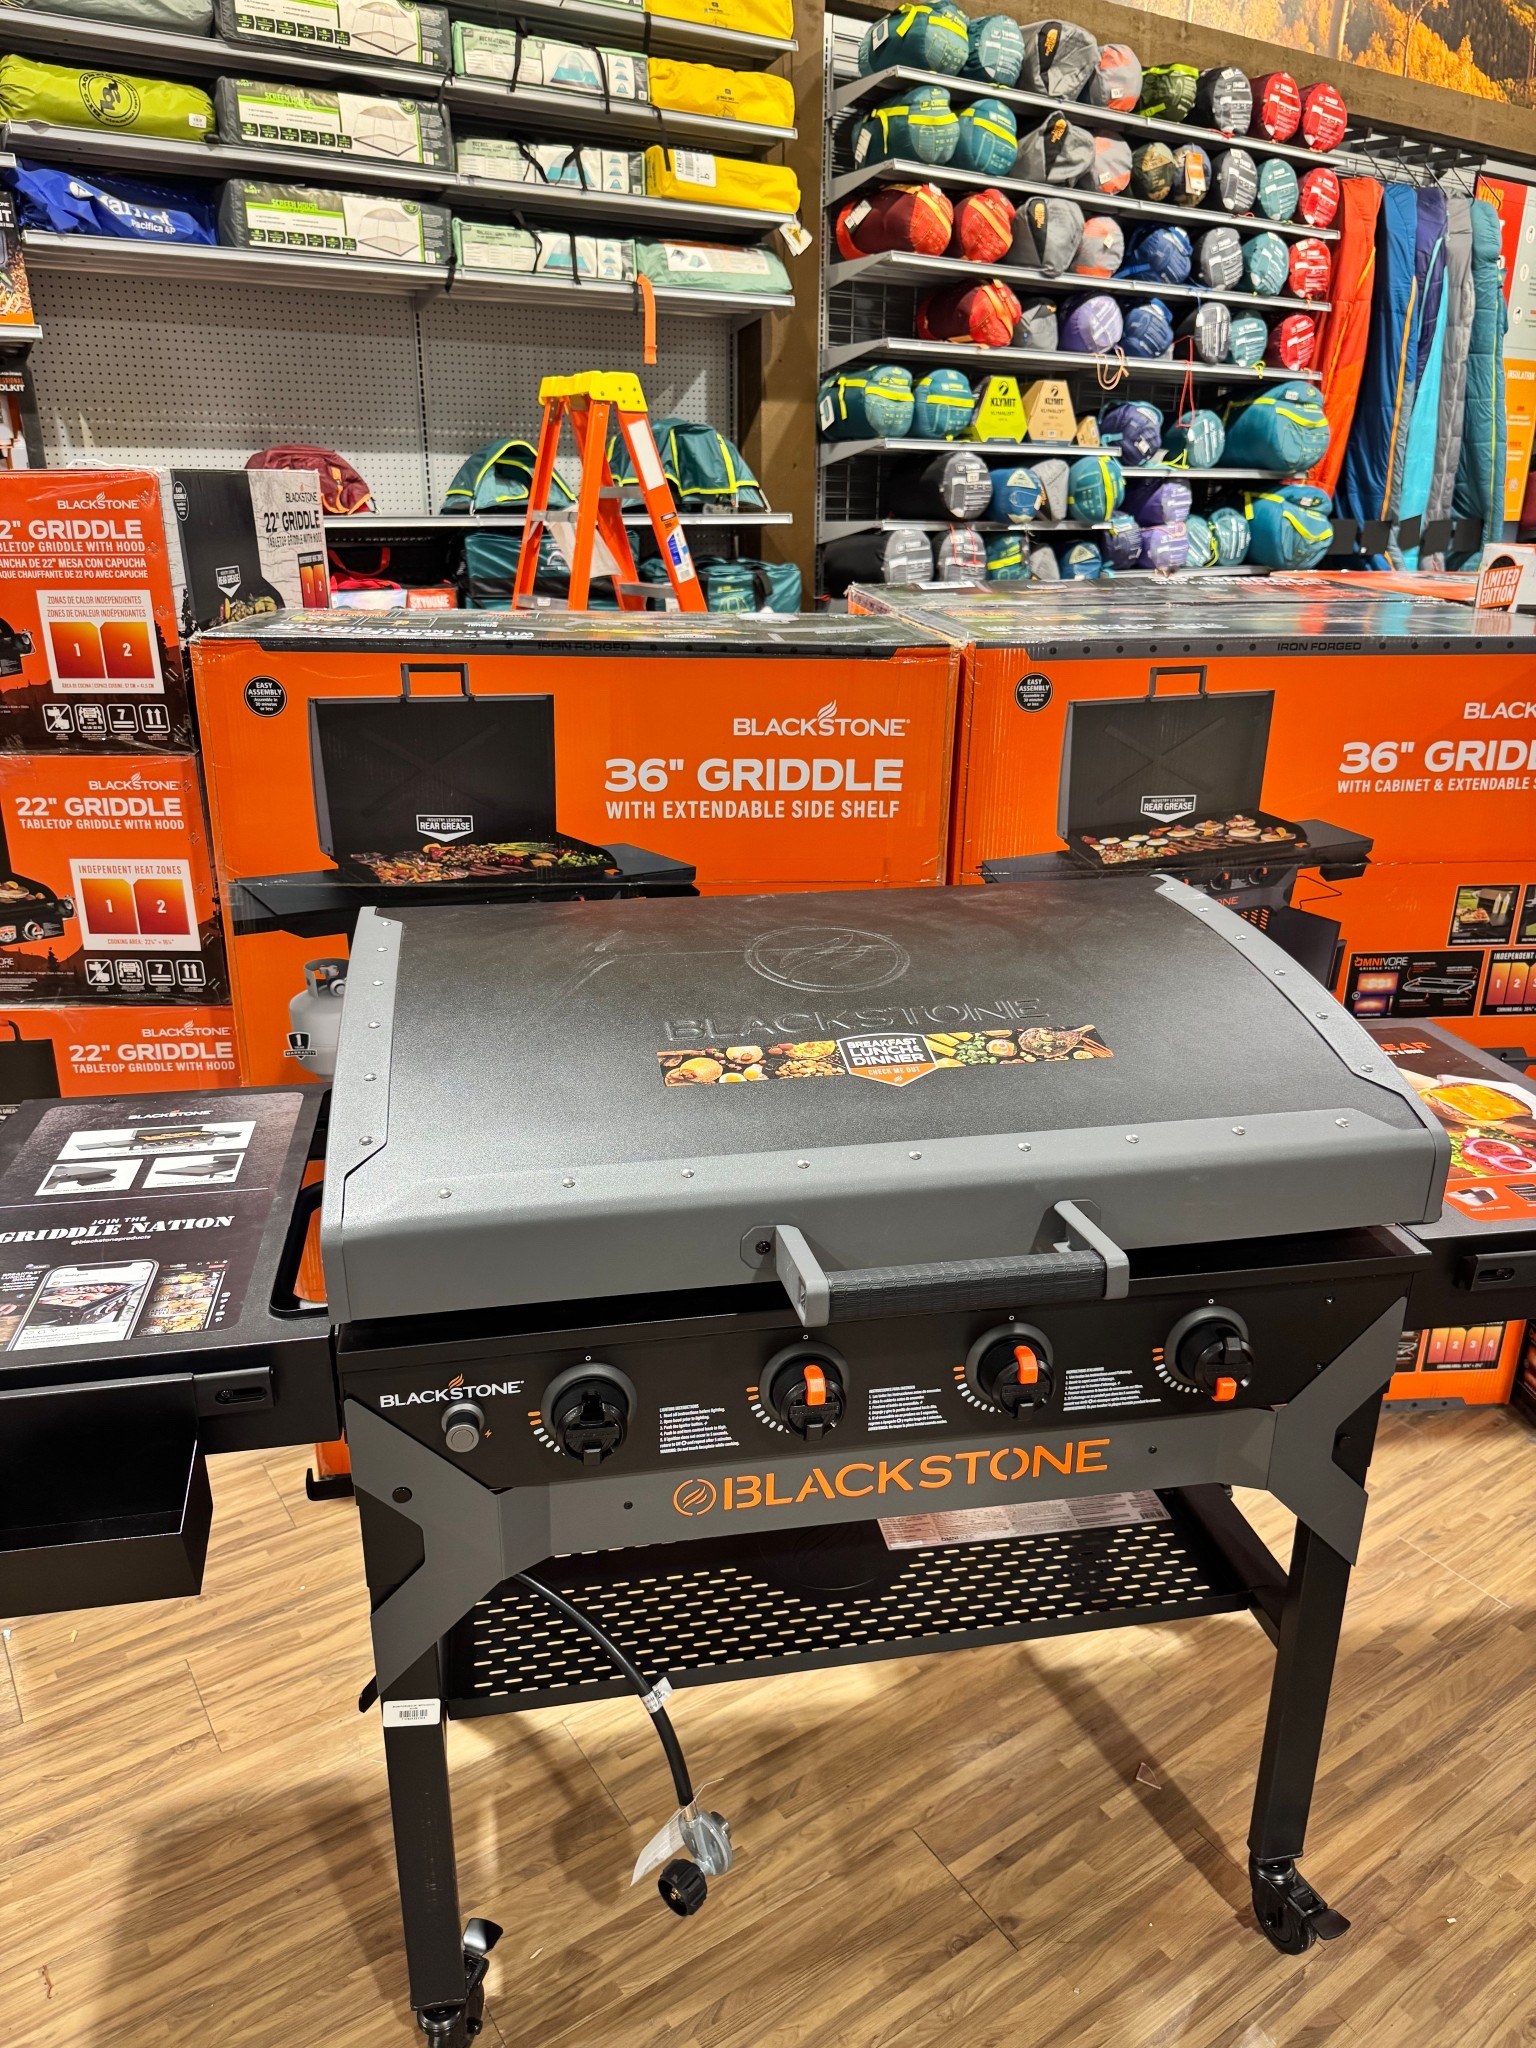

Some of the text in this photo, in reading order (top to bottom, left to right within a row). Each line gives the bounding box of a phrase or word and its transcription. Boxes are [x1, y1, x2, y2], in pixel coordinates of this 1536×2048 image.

[131, 219, 176, 234] Pacifica 4P
[1507, 370, 1535, 380] INSULATION
[991, 398, 1016, 407] KLYMIT
[1045, 398, 1064, 406] KLYMIT
[285, 492, 318, 503] BLACKSTONE
[57, 499, 139, 509] BLACKSTONE
[264, 510, 320, 533] 22" GRIDDLE
[28, 520, 143, 539] GRIDDLE
[38, 542, 83, 552] GRIDDLE
[86, 542, 113, 552] WITH
[117, 542, 145, 552] HOOD
[29, 559, 41, 568] DE
[42, 558, 56, 568] 22"
[58, 559, 83, 568] MESA
[85, 559, 103, 568] CON
[106, 558, 146, 568] CAPUCHA
[18, 570, 148, 578] CHAUFFANTE DE 22 PO AVEC CAPUCHE
[1483, 568, 1520, 588] LIMITED
[48, 596, 142, 604] ZONAS DE CALOR INDEPENDIENTES
[1481, 584, 1515, 606] EDITION
[410, 598, 450, 609] SKYDOME
[75, 609, 100, 617] CHALEUR
[73, 643, 132, 657] 1 2
[537, 642, 632, 653] IRON FORGED
[1277, 642, 1362, 651] IRON FORGED
[117, 709, 126, 721] 7
[733, 715, 907, 736] BLACKSTONE
[1339, 740, 1536, 774] 36" GRID
[604, 758, 904, 792] 36" GRIDDLE
[88, 780, 180, 791] BLACKSTONE
[1337, 776, 1530, 794] WITH CABINET & EXTENDABLE
[15, 797, 183, 817] 22" GRIDDLE
[606, 800, 900, 820] WITH EXTENDABLE SIDE SHELF
[1143, 801, 1194, 812] REAR GREASE
[19, 819, 185, 830] TABLETOP GRIDDLE WITH HOOD
[420, 821, 472, 832] REAR GREASE
[78, 864, 182, 875] INDEPENDENT HEAT ZONES
[105, 900, 167, 914] 1 2
[1354, 956, 1408, 967] OMNIVORE
[1493, 952, 1534, 960] INDEPENDENT
[155, 964, 163, 974] 7
[1496, 978, 1521, 989] 1 2
[665, 998, 1051, 1042] BLACKSTONE
[142, 1026, 231, 1038] BLACKSTONE
[296, 1034, 302, 1046] 1
[846, 1036, 918, 1049] BREAKFAST
[849, 1045, 911, 1057] LUNCH
[1380, 1042, 1432, 1050] EAR
[69, 1042, 233, 1062] 22" GRIDDLE
[855, 1052, 928, 1066] DINNER
[72, 1061, 235, 1073] TABLETOP GRIDDLE WITH HOOD
[867, 1068, 891, 1077] CHECK
[906, 1066, 921, 1074] OUT
[128, 1109, 211, 1120] BLACKSTONE
[0, 1216, 235, 1244] GRIDDLE NATION
[1436, 1341, 1441, 1350] 1
[1452, 1340, 1459, 1349] 2
[1470, 1340, 1477, 1349] 3
[380, 1381, 521, 1408] BLACKSTONE
[723, 1438, 1111, 1511] BLACKSTONE
